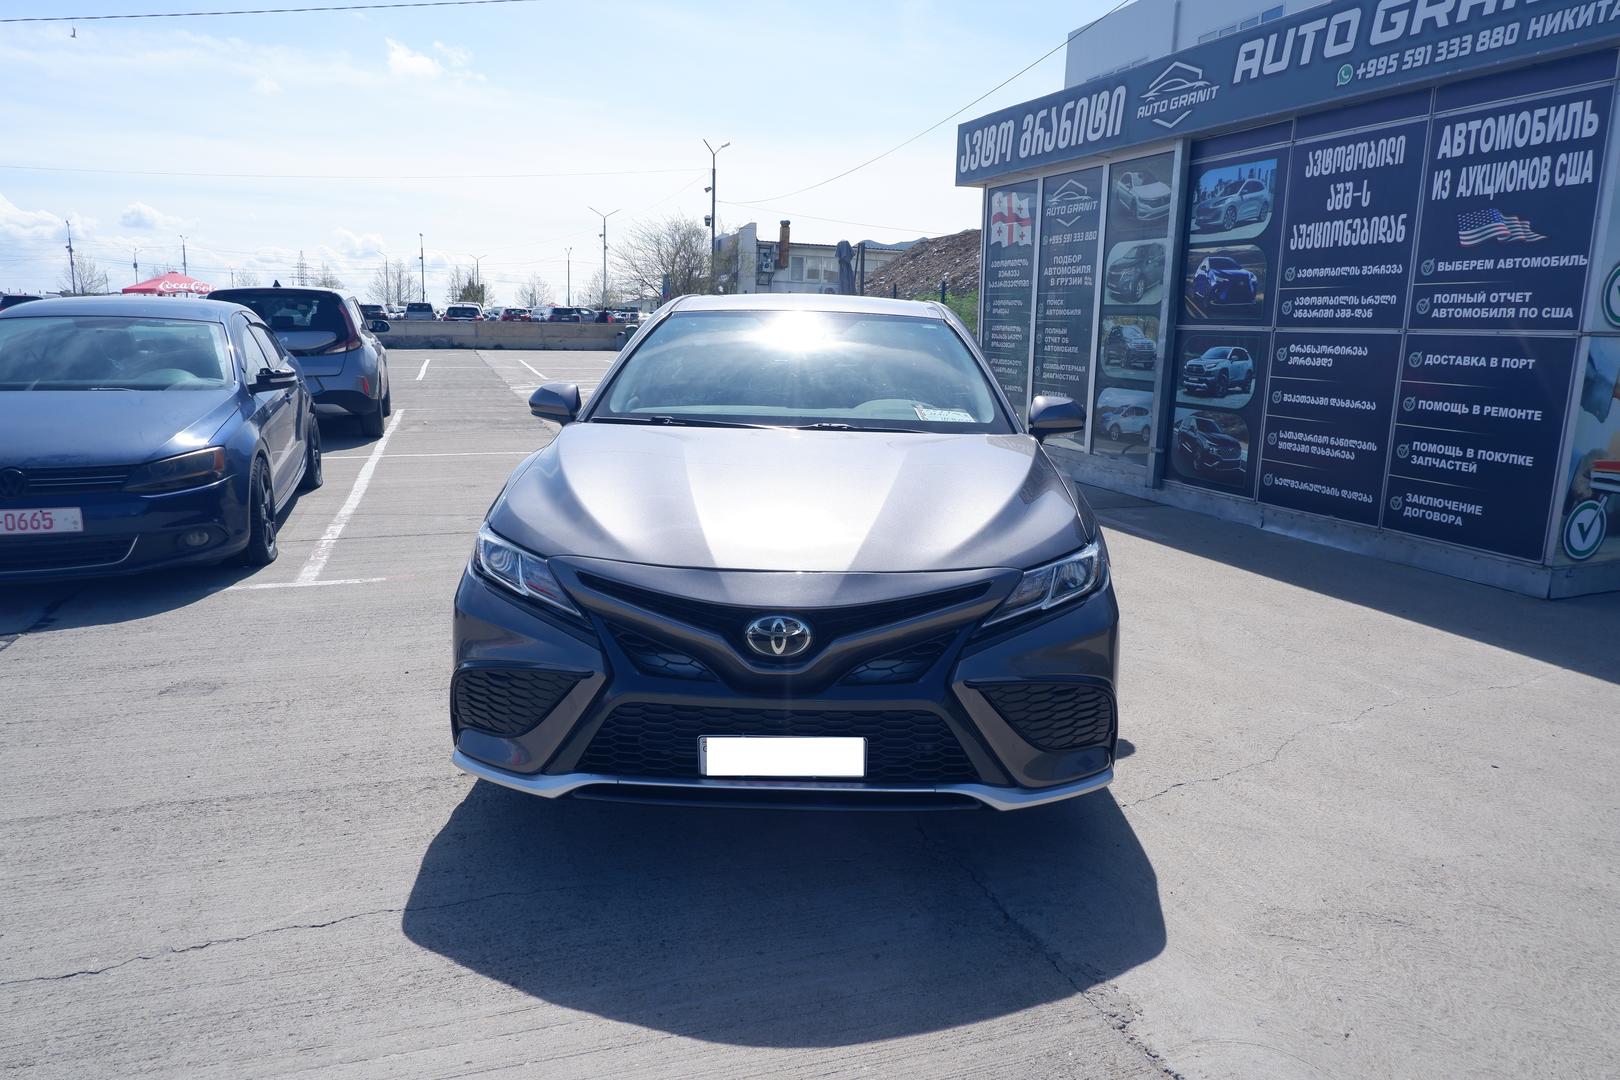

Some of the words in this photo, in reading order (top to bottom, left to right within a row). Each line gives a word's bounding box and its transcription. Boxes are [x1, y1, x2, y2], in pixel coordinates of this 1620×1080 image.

[1232, 7, 1362, 84] AUTO
[1369, 0, 1540, 46] GR
[1356, 52, 1400, 80] +995
[1401, 44, 1433, 70] 591
[1434, 34, 1473, 62] 333
[1475, 22, 1520, 52] 880
[1136, 99, 1168, 119] AUTO
[1169, 85, 1220, 110] GRANIT
[960, 119, 1015, 173] ავტო
[1018, 85, 1127, 158] გრანიტი
[1437, 100, 1599, 159] АВТОМОБИЛЬ
[1305, 135, 1406, 178] ავტომობილი
[1431, 169, 1451, 200] ИЗ
[1456, 155, 1551, 200] АУКЦИОНОВ
[1554, 150, 1593, 187] США
[1326, 179, 1371, 211] აშშ-ს
[1046, 205, 1066, 216] AUTO
[1067, 200, 1098, 213] GRANIT
[1290, 213, 1407, 250] აუქციონებიდან
[1053, 254, 1082, 265] ПОДБОР
[1437, 258, 1494, 272] ВЫБЕРЕМ
[1496, 255, 1588, 269] АВТОМОБИЛЬ
[1043, 265, 1091, 276] АВТОМОБИЛЯ
[1297, 266, 1360, 278] ავტომობილის
[1361, 264, 1403, 275] შერჩევა
[1050, 277, 1055, 286] В
[1056, 276, 1083, 285] ГРУЗИИ
[1294, 295, 1360, 306] ავტომობილის
[1361, 295, 1397, 305] სრული
[1433, 291, 1486, 304] ПОЛНЫЙ
[1489, 292, 1532, 303] ОТЧЕТ
[1431, 307, 1515, 318] АВТОМОБИЛЯ
[1519, 307, 1538, 318] ПО
[1541, 307, 1573, 318] США
[1424, 354, 1487, 367] ДОСТАВКА
[1490, 357, 1498, 367] В
[1501, 358, 1536, 369] ПОРТ
[1417, 400, 1469, 415] ПОМОЩЬ
[1472, 405, 1481, 414] В
[1483, 405, 1542, 421] РЕМОНТЕ
[1410, 455, 1477, 473] ЗАПЧАСТЕЙ
[1412, 441, 1463, 457] ПОМОЩЬ
[1466, 448, 1474, 458] В
[1477, 449, 1534, 467] ПОКУПКЕ
[1405, 492, 1483, 515] ЗАКЛЮЧЕНИЕ
[1403, 506, 1463, 526] ДОГОВОРА
